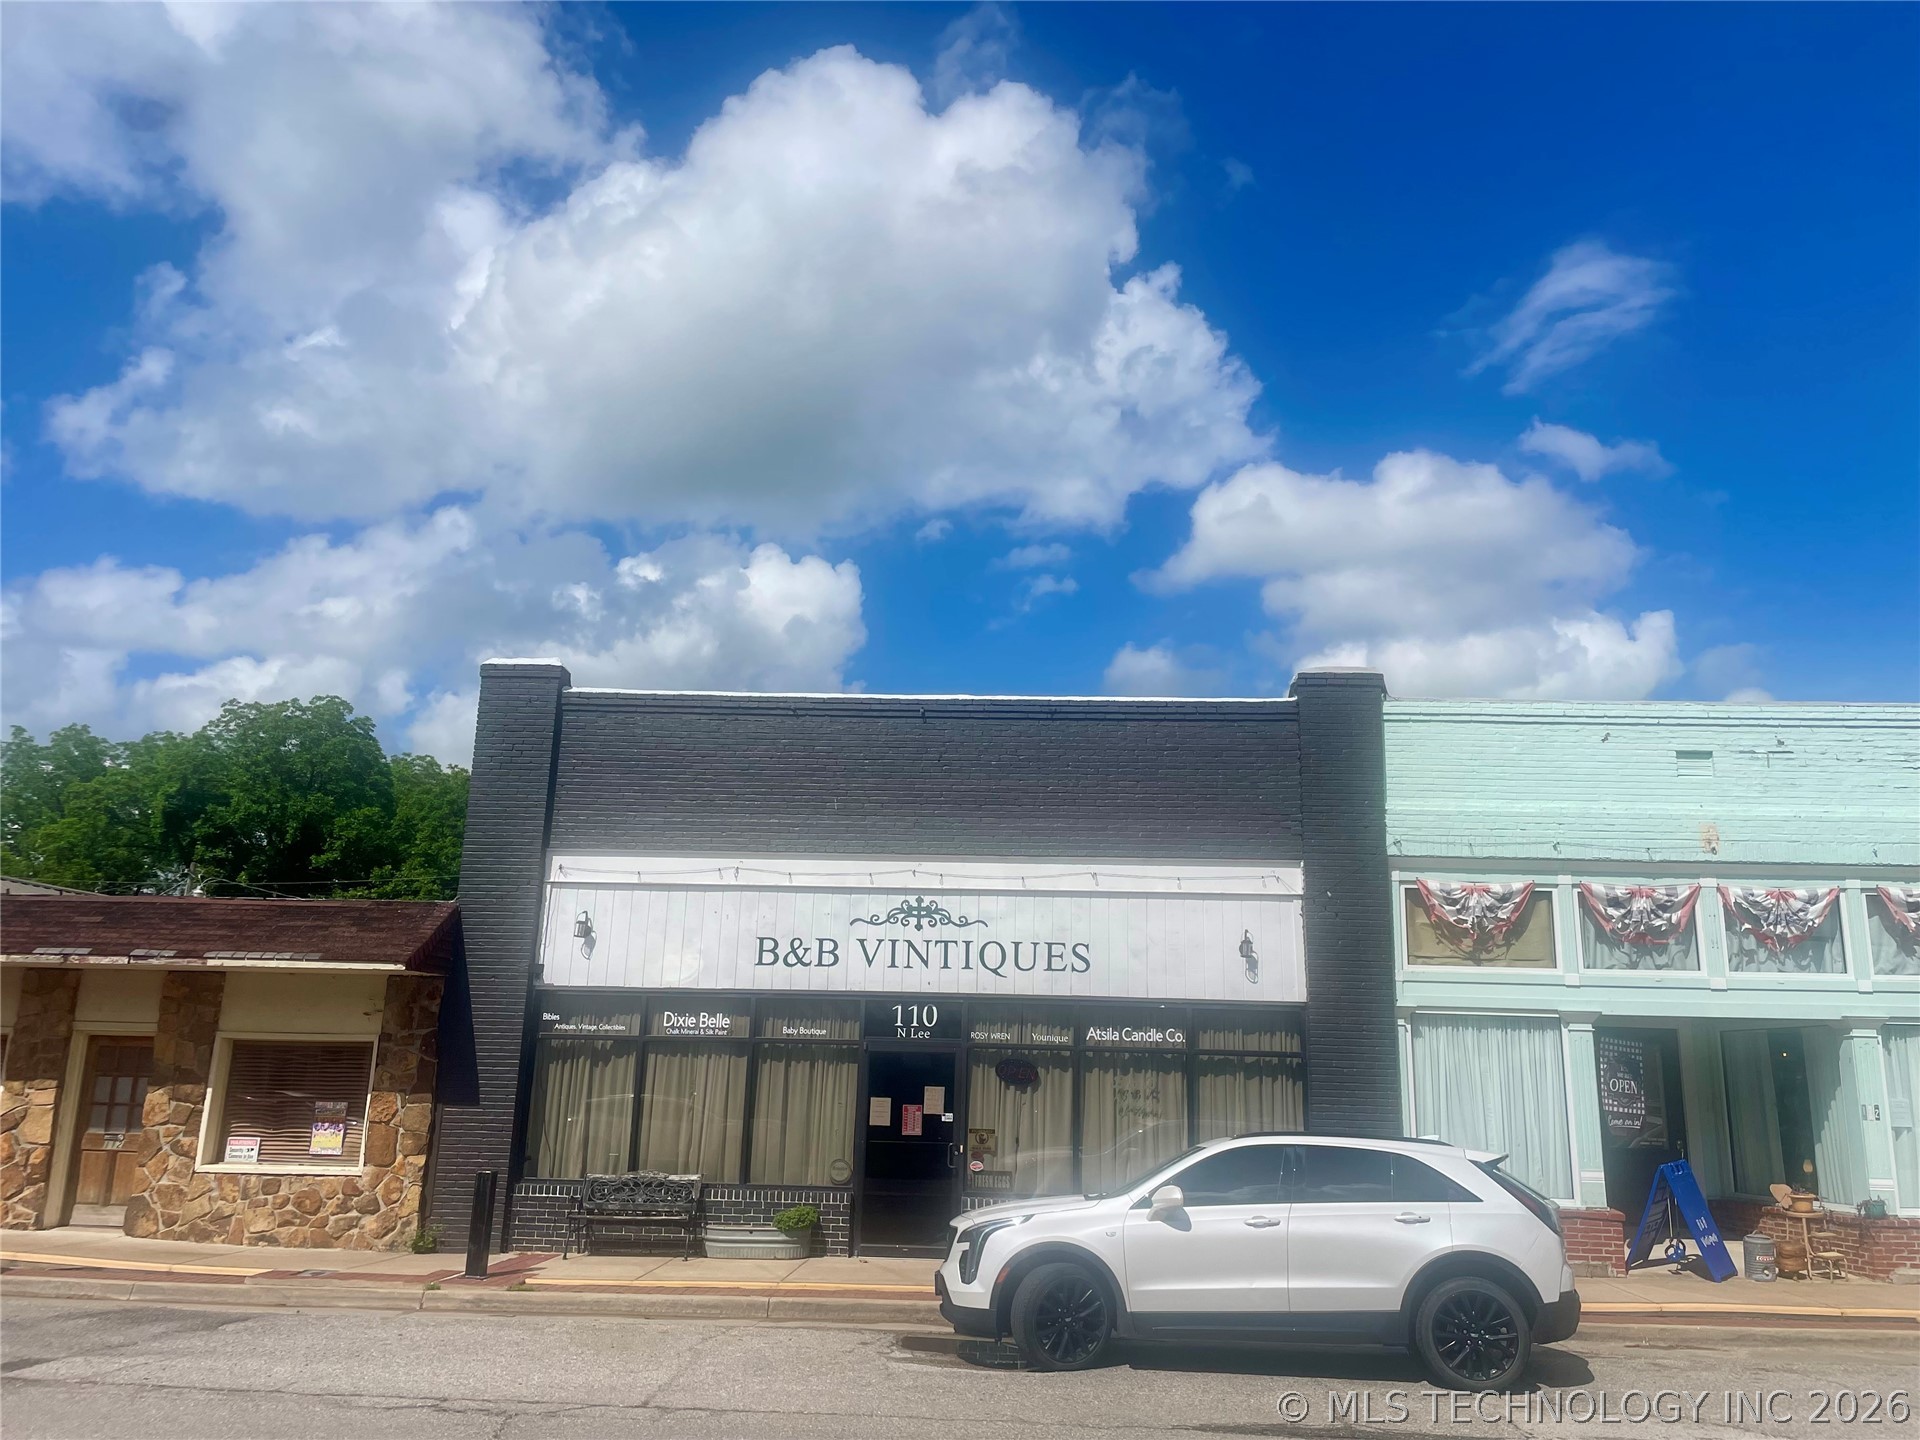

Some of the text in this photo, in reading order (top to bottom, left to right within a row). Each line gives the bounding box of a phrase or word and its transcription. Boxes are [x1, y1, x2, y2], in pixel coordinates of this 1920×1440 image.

[755, 936, 1092, 978] B&B VINTIQUES
[542, 1012, 560, 1021] Bibles
[663, 1011, 730, 1028] Dixie Belle
[891, 1003, 938, 1028] 110
[598, 1023, 626, 1031] Collectibles
[782, 1026, 827, 1036] Baby Boutique
[897, 1027, 931, 1039] N Lee
[970, 1031, 1011, 1040] ROSY WREN
[1031, 1032, 1069, 1044] Younique
[1086, 1027, 1186, 1043] Atsila Candle Co.
[1609, 1078, 1638, 1095] OPEN
